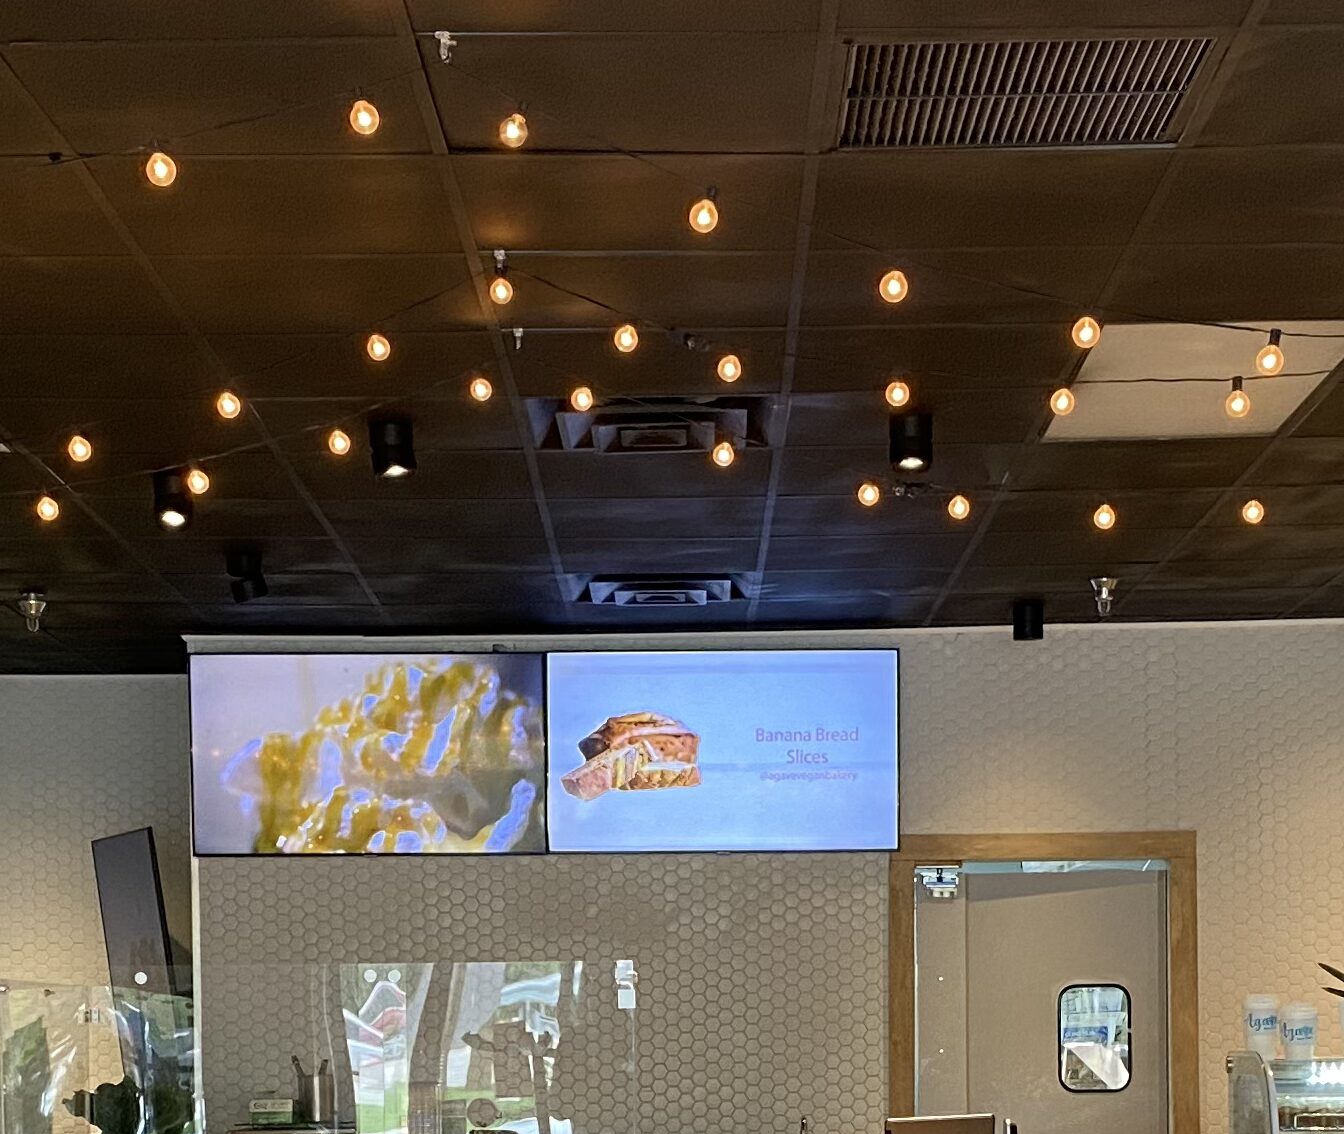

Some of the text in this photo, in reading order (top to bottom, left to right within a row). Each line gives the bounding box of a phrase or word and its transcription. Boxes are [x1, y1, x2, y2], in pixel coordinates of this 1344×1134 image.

[755, 727, 859, 742] Banana Bread
[786, 749, 829, 764] Slices
